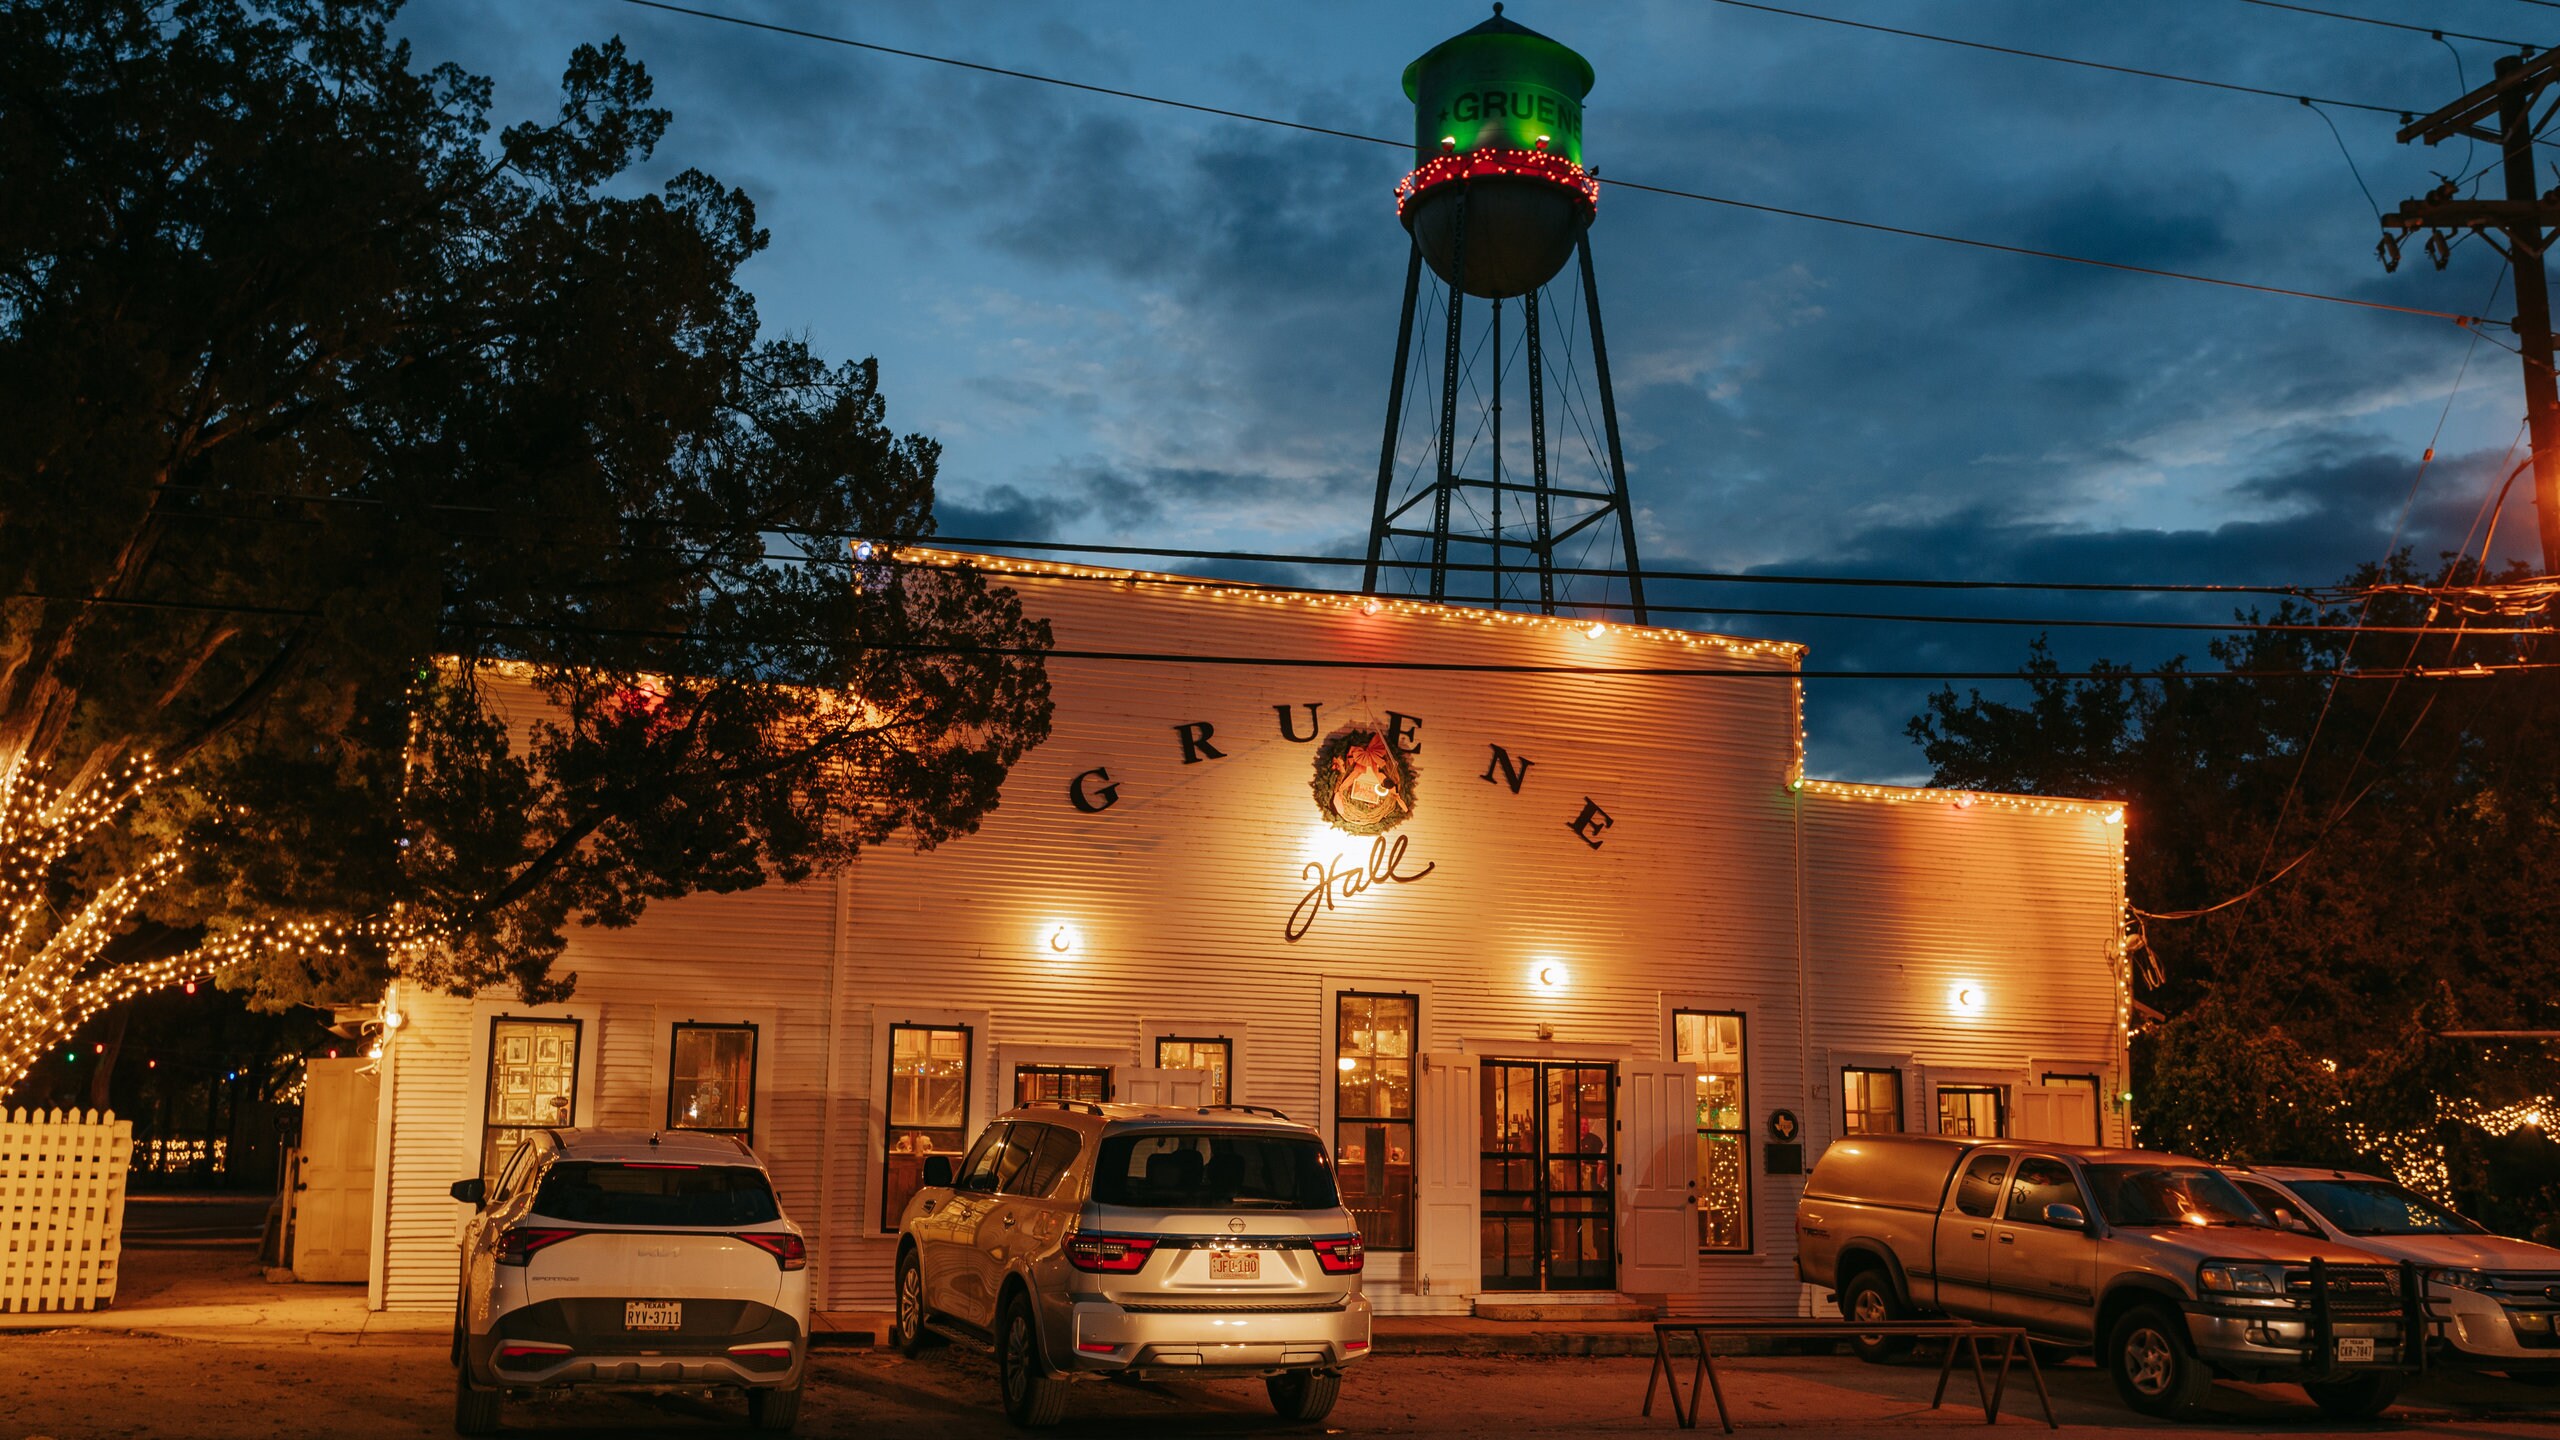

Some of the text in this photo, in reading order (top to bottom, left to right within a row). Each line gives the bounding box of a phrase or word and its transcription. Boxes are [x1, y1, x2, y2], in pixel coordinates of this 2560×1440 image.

[1453, 91, 1582, 144] GRUENE
[1069, 702, 1614, 851] GRUENE
[1284, 834, 1435, 942] Hall
